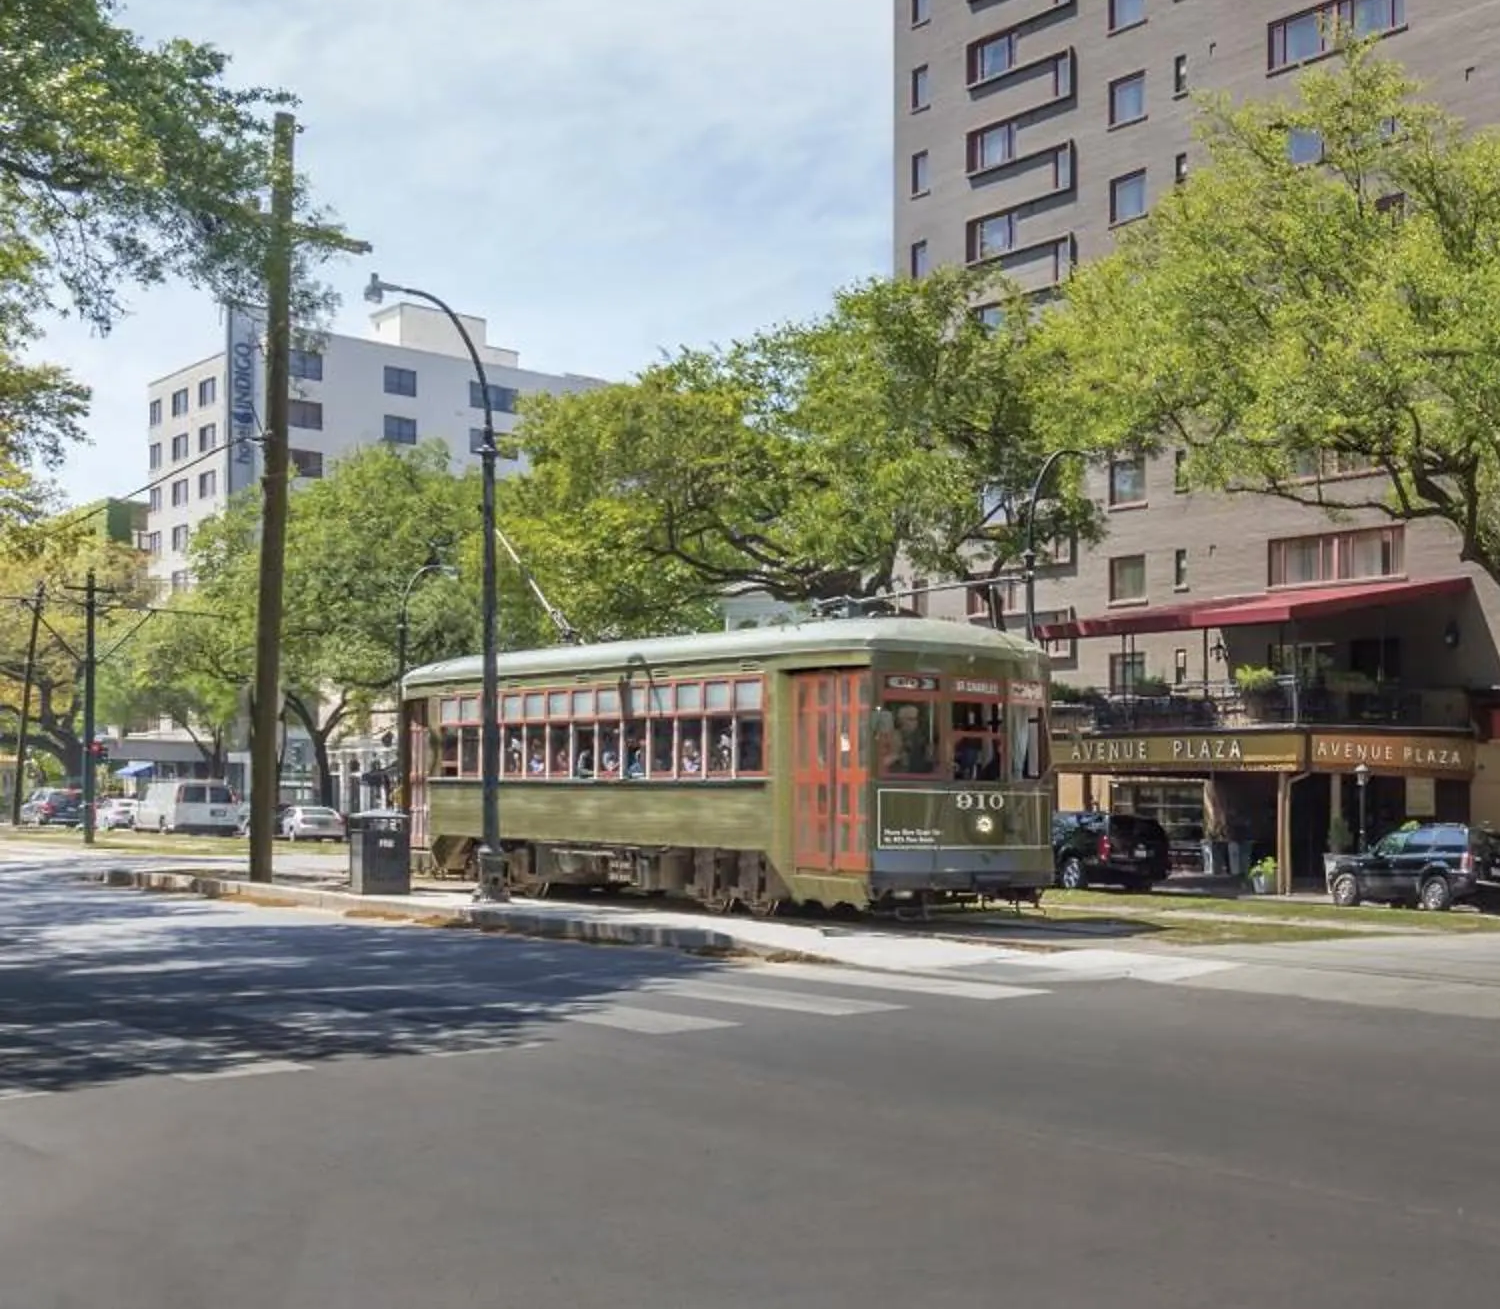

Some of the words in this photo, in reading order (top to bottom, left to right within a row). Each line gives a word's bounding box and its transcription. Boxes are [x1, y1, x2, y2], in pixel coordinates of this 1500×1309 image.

[234, 342, 251, 411] INDIGO
[1071, 741, 1147, 761] AVENUE
[1173, 740, 1241, 759] PLAZA
[1317, 742, 1393, 761] AVENUE
[1403, 746, 1462, 764] PLAZA
[956, 793, 1005, 809] 910
